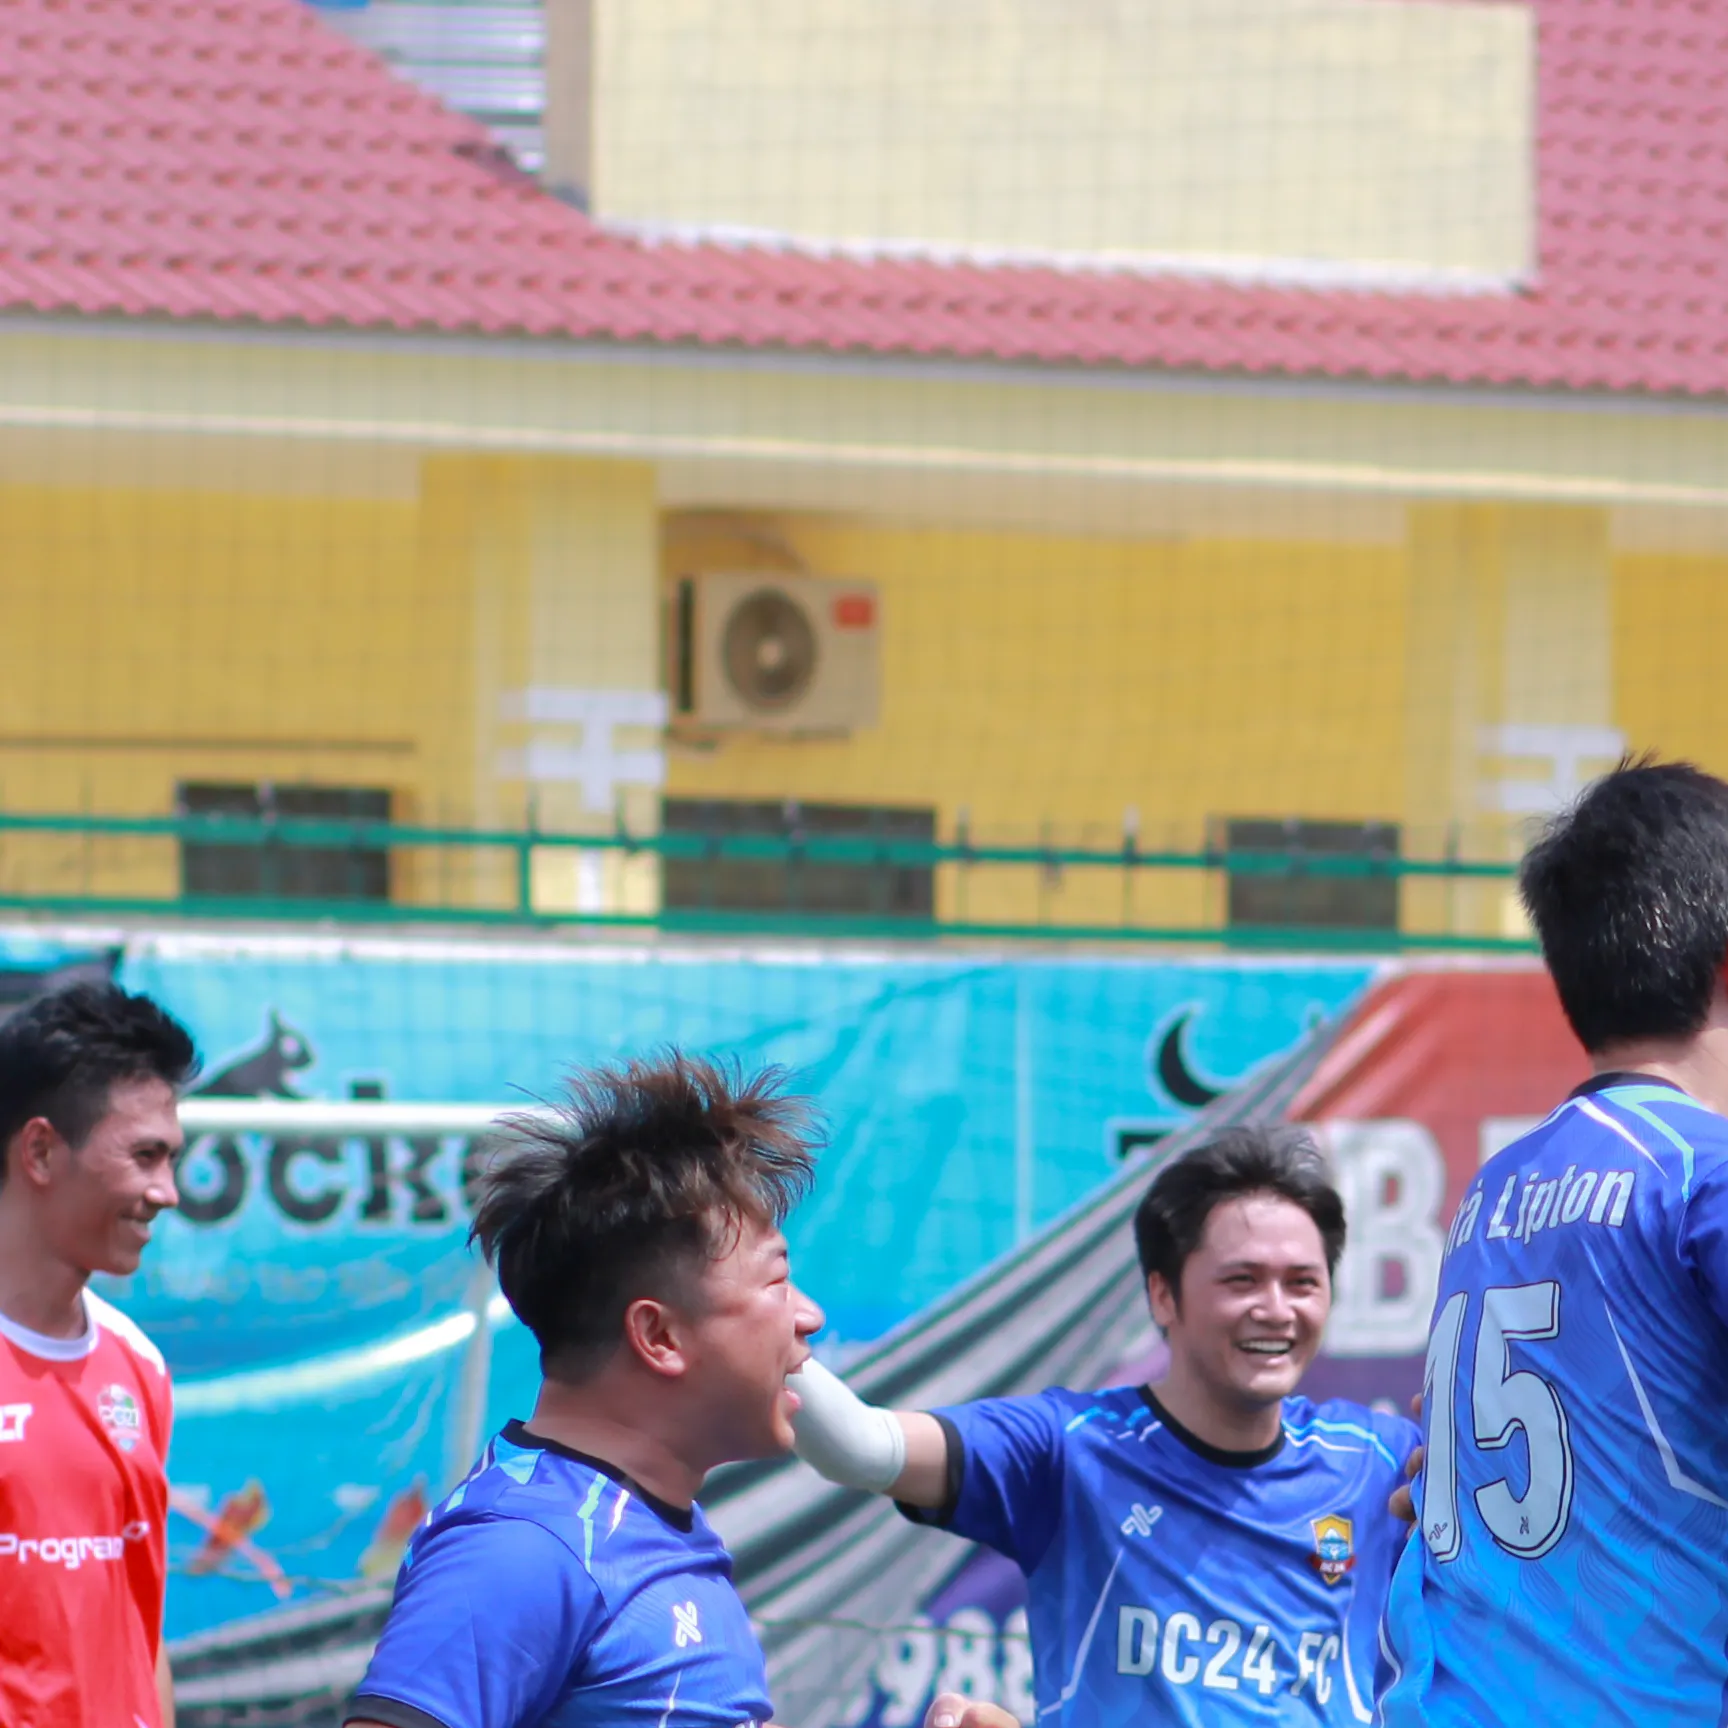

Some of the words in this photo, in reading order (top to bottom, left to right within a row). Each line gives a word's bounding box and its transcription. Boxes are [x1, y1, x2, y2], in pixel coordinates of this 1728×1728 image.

[1486, 1164, 1636, 1245] Lipton
[1421, 1281, 1574, 1563] 15
[1116, 1605, 1277, 1695] DC24
[1290, 1629, 1341, 1705] FC
